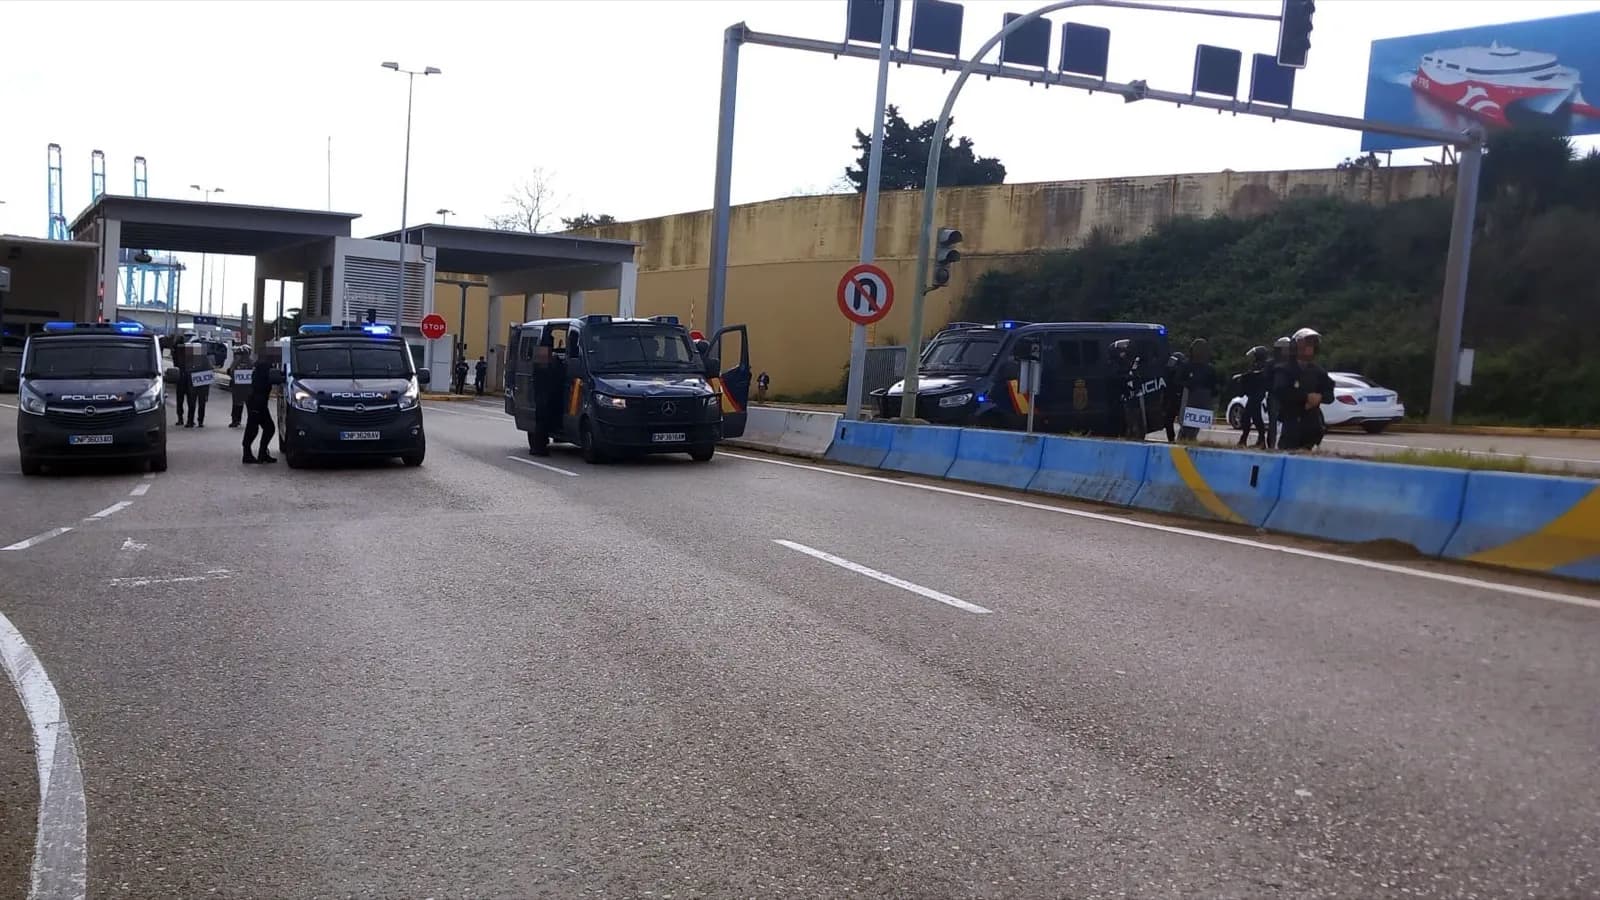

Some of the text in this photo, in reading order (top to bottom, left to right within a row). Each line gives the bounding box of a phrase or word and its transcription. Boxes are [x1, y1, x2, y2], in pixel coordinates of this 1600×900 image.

[423, 323, 444, 331] STOP
[192, 373, 214, 384] POLICIA
[235, 373, 251, 382] POLIC
[1184, 412, 1211, 425] POLICIA
